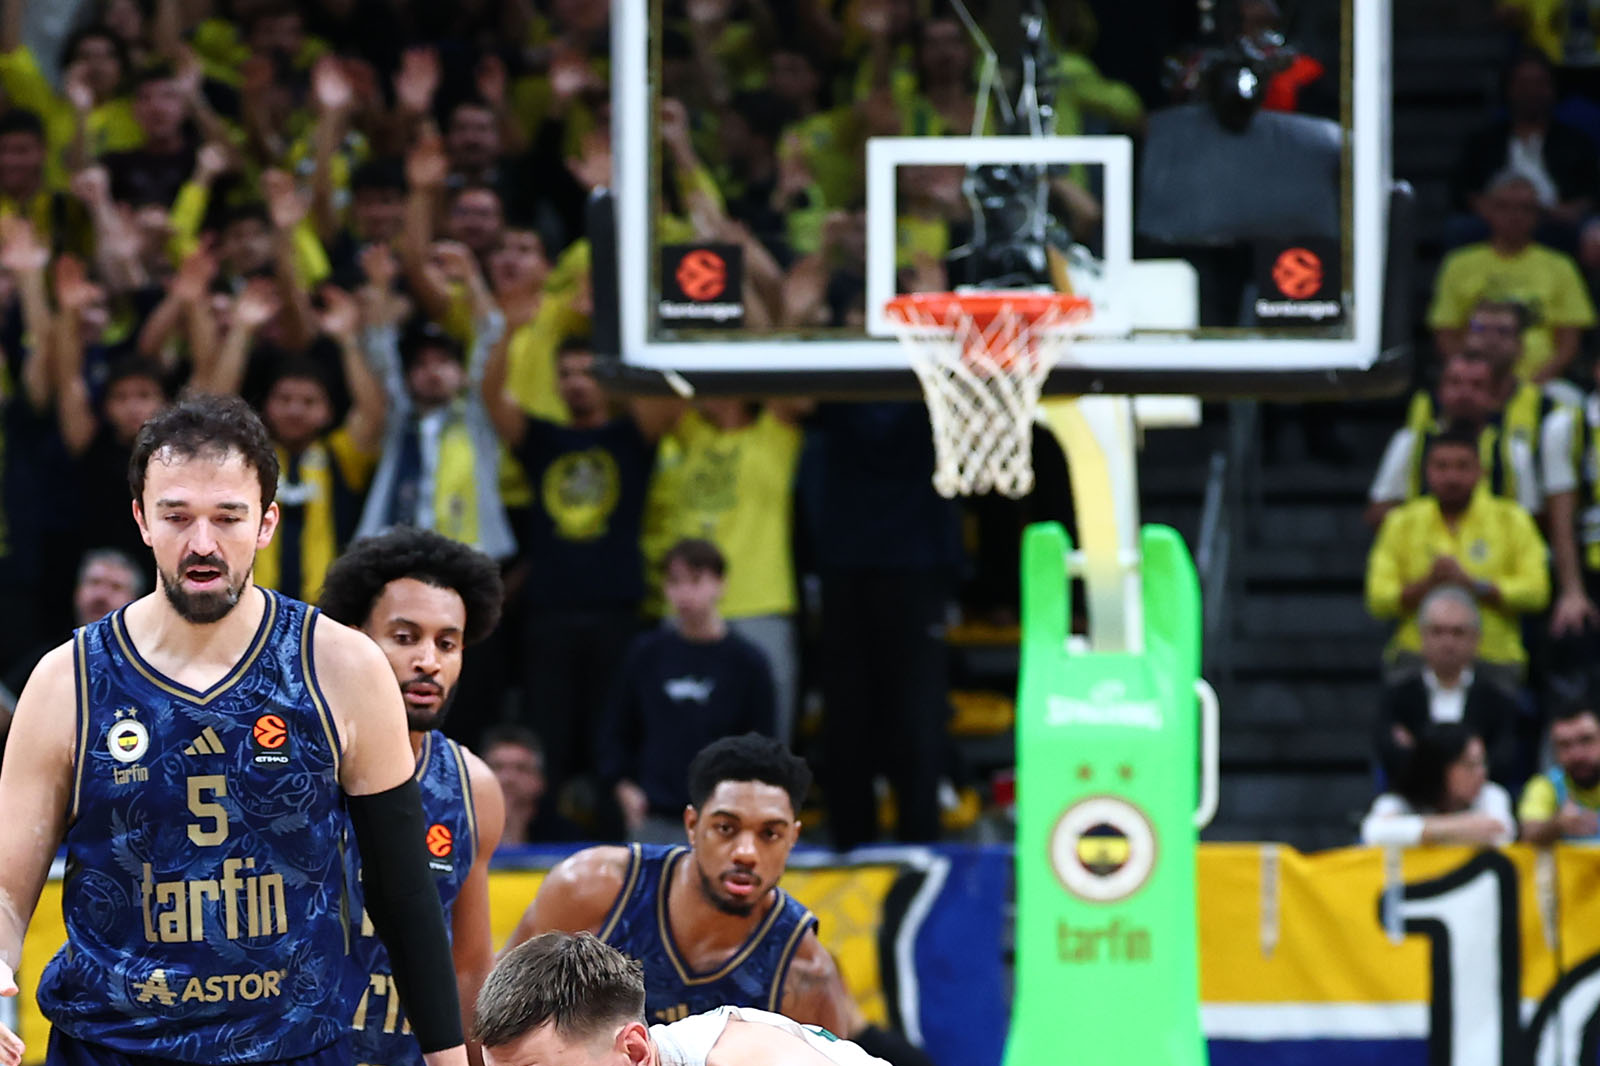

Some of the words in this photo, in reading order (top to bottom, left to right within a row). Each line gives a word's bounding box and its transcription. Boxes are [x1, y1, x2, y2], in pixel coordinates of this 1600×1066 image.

[113, 763, 149, 785] tarfin
[187, 775, 229, 847] 5
[141, 857, 288, 943] tarfin
[1057, 919, 1152, 964] tarfin
